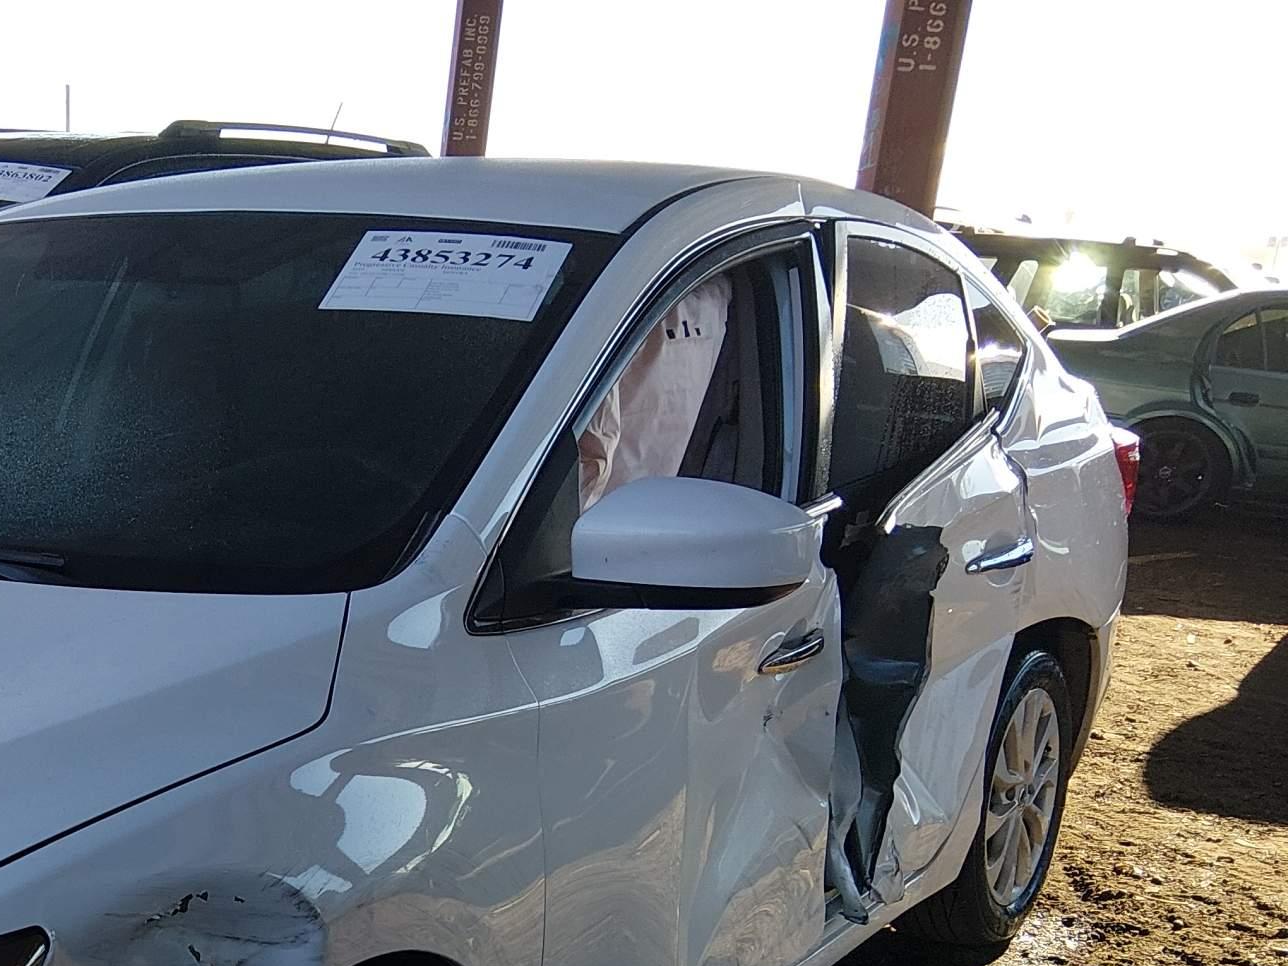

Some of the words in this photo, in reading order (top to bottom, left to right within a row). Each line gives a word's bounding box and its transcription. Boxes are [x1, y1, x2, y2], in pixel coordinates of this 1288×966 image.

[464, 13, 478, 41] INC.
[897, 26, 921, 72] U.S.
[458, 50, 473, 105] PREFAB
[465, 15, 491, 141] 1-866-799-0969
[452, 113, 466, 141] U.S.
[371, 247, 535, 270] 43853274
